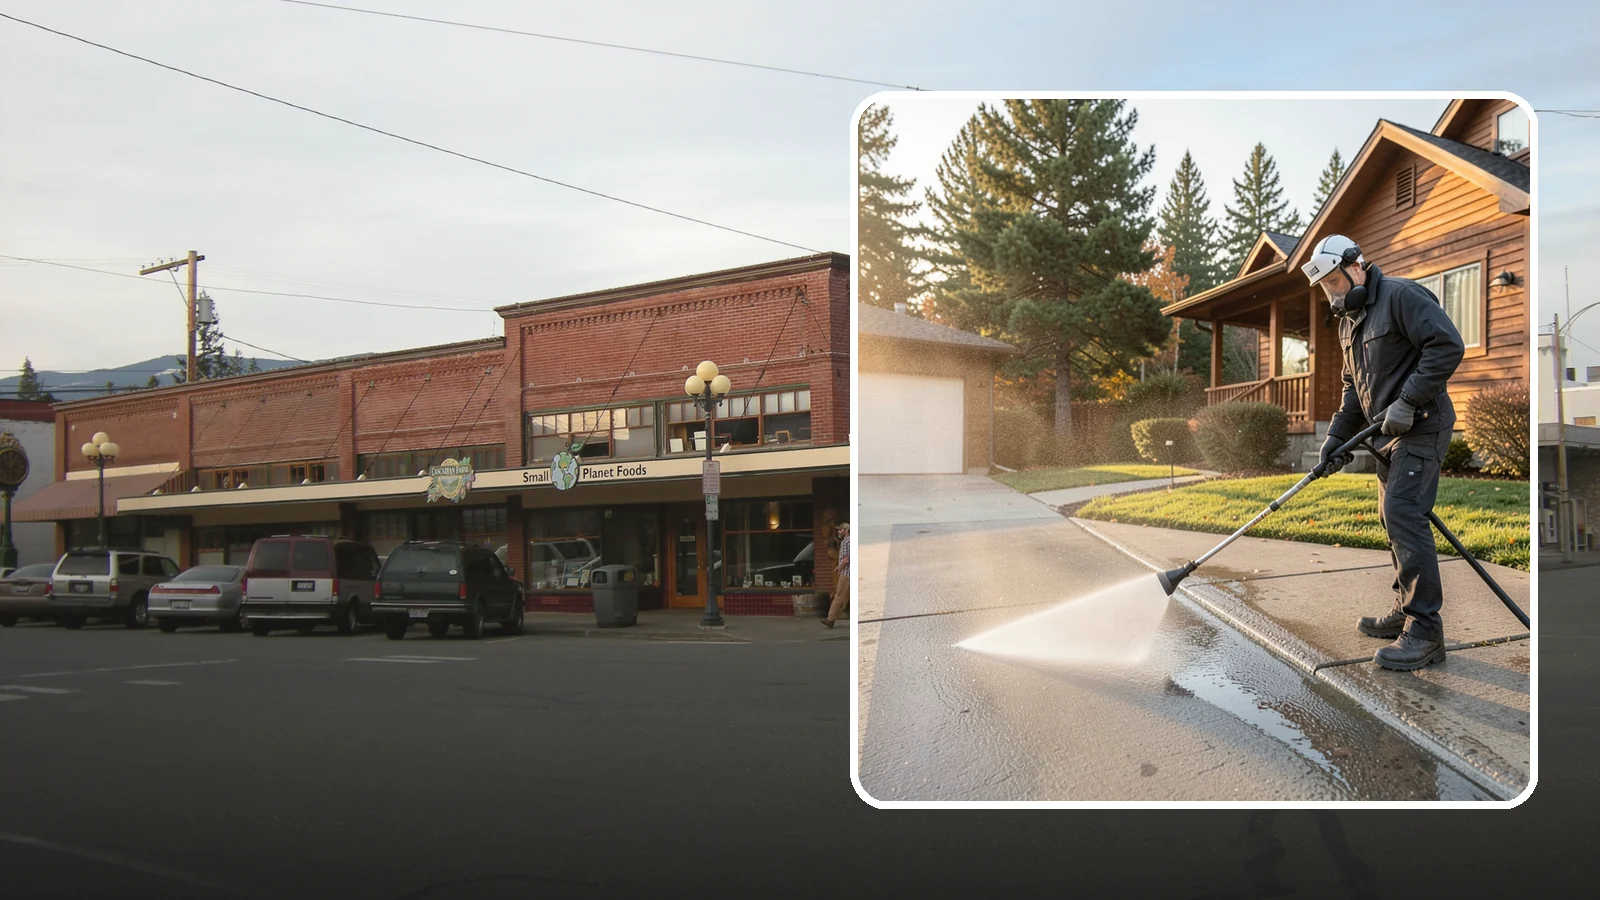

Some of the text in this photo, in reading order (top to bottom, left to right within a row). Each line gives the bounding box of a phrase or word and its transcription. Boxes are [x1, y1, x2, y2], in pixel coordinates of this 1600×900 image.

[523, 464, 647, 483] Small Planet Foods
